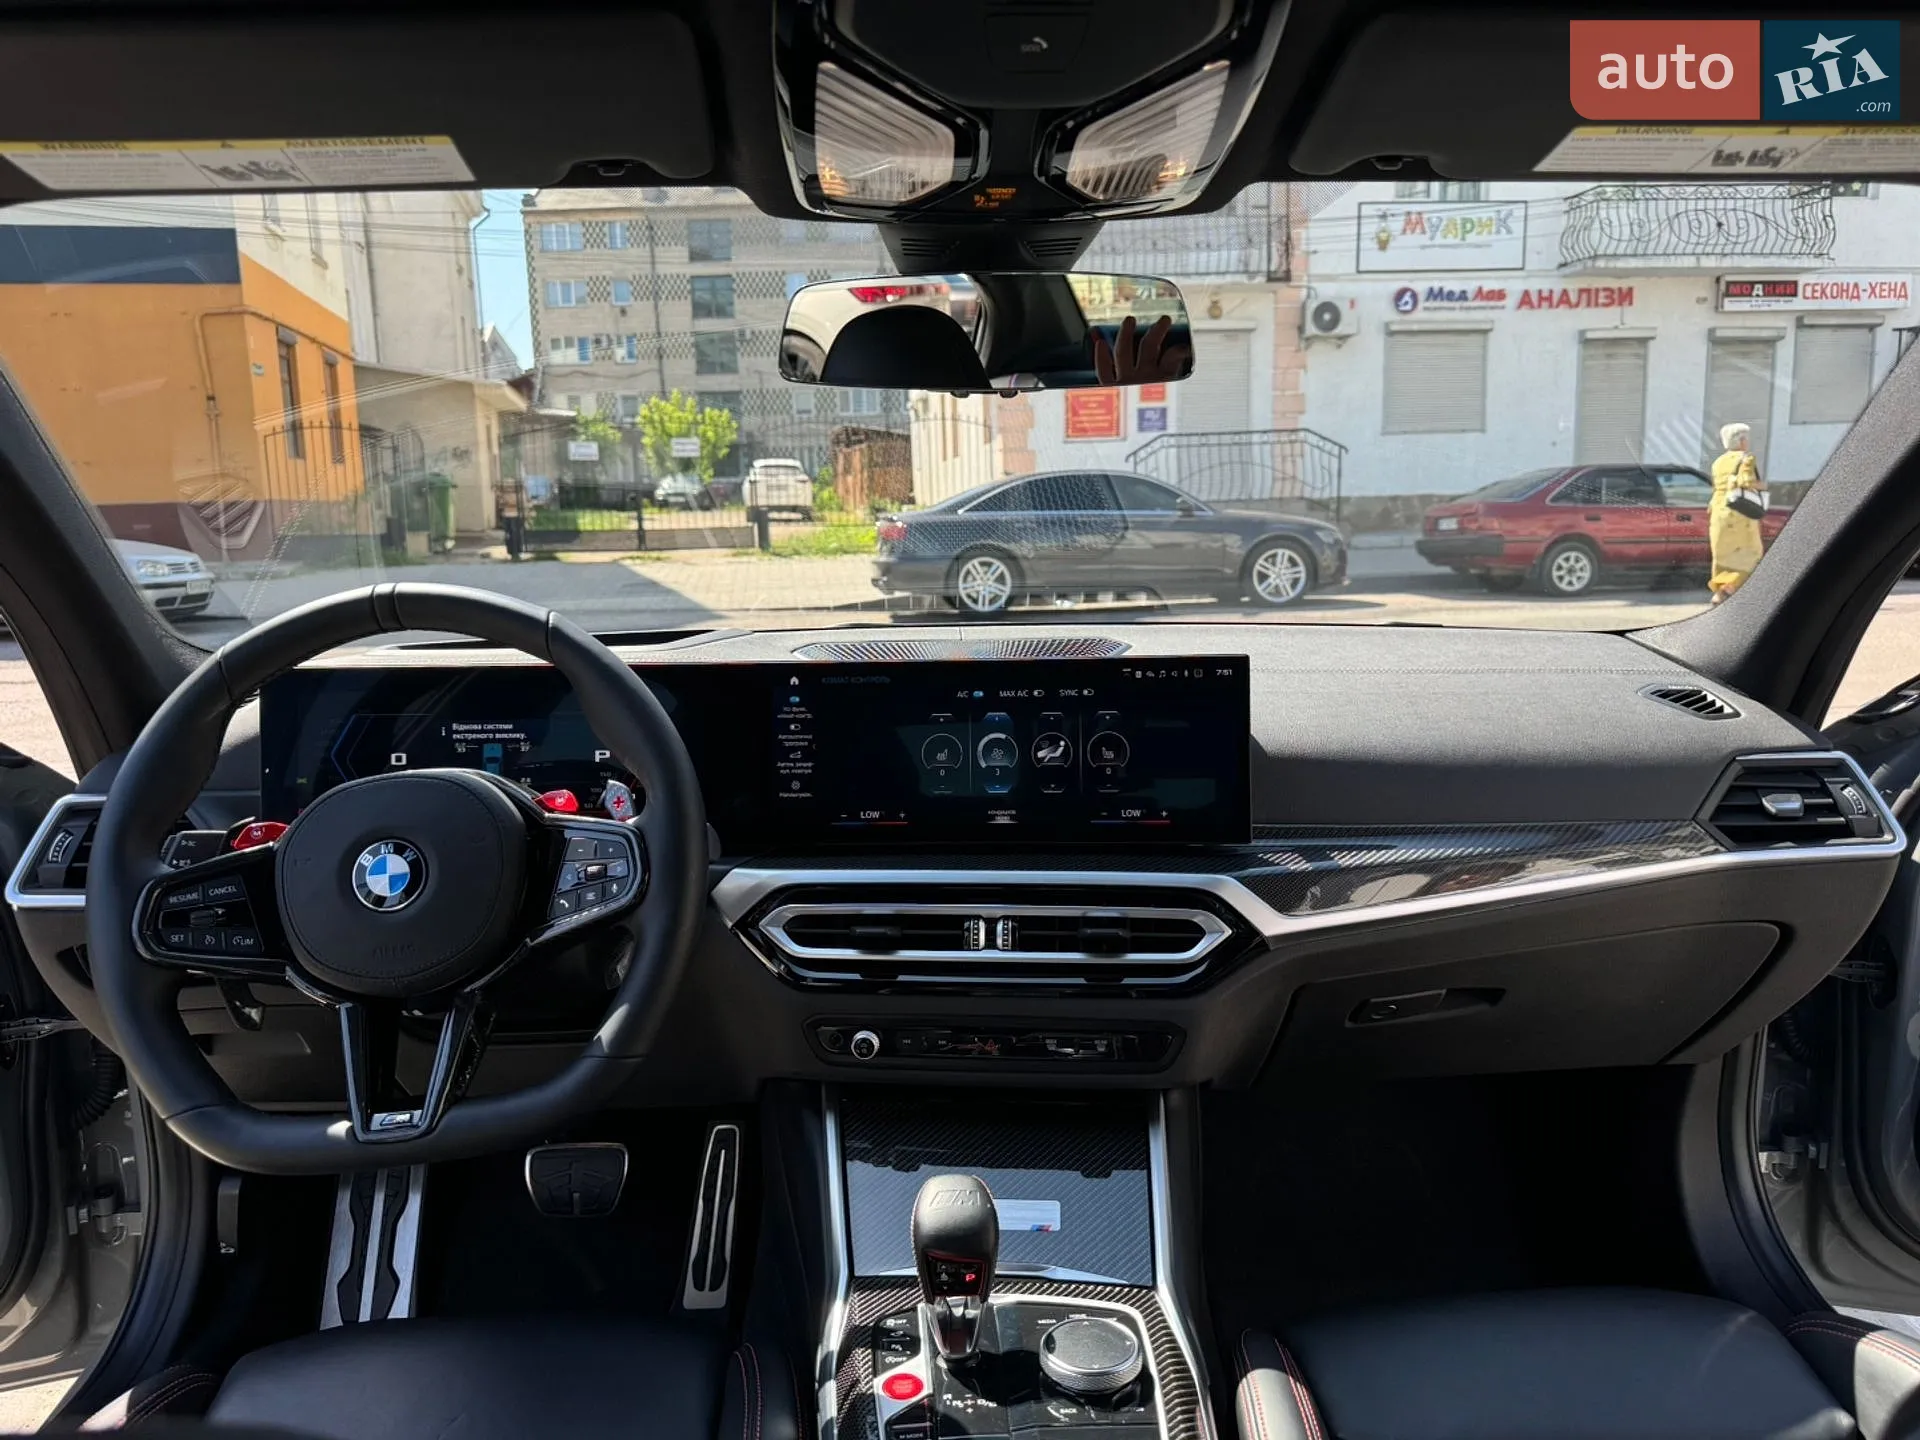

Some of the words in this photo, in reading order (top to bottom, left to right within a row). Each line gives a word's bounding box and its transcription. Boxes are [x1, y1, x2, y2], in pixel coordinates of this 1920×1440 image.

[1802, 281, 1909, 301] СЕКОНД-ХЕНД
[1517, 286, 1634, 310] АНАЛІЗИ
[1059, 689, 1079, 697] SYNC
[594, 750, 611, 762] P
[1121, 809, 1141, 817] LOW
[360, 843, 418, 867] BMW
[208, 885, 238, 896] CANCEL
[170, 934, 185, 943] SET
